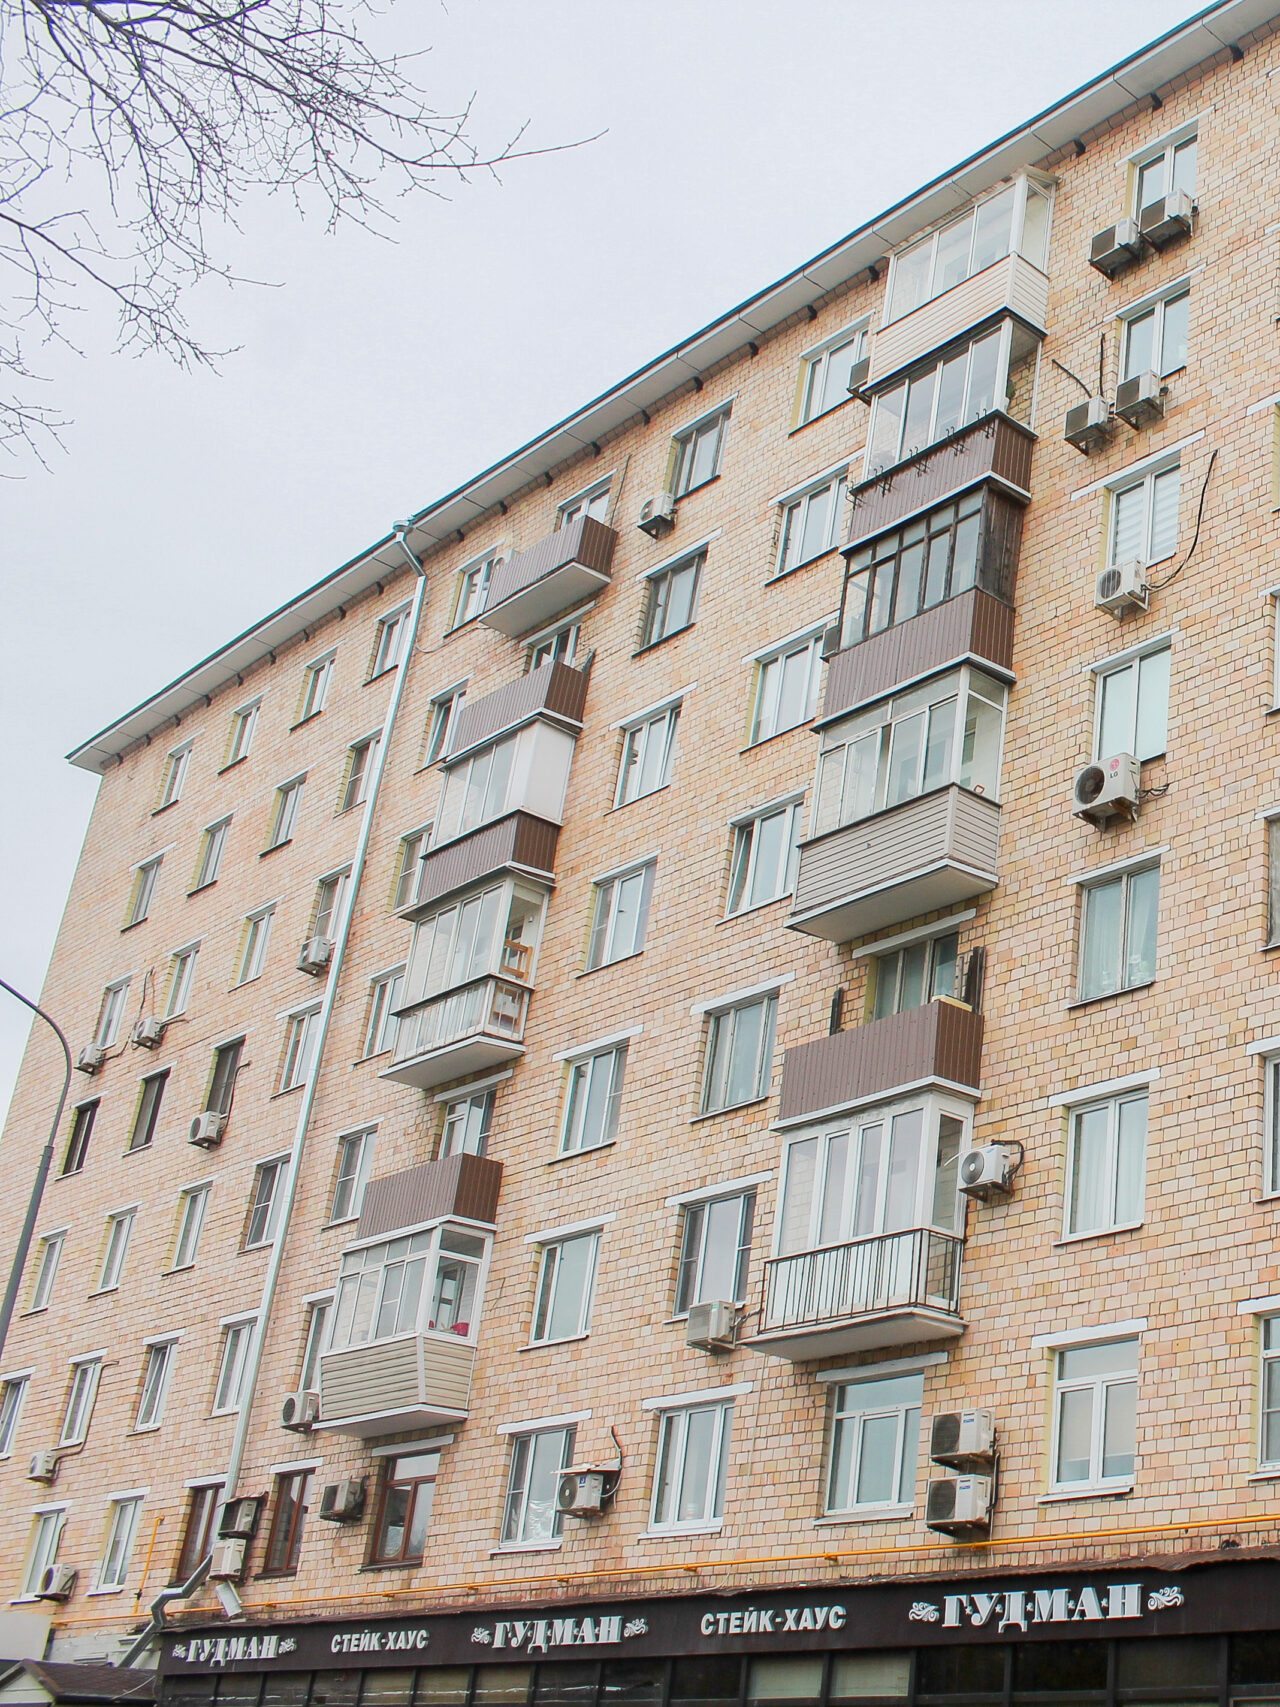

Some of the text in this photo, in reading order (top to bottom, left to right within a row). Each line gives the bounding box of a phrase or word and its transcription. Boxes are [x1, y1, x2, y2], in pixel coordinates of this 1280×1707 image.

[1109, 771, 1118, 779] LG
[700, 1605, 847, 1635] СТЕЙК-ХАУС
[942, 1583, 1144, 1633] ГУДМАН
[331, 1629, 429, 1653] СТЕЙК-ХАУС
[492, 1616, 624, 1653] ГУДМАН
[186, 1635, 279, 1667] ГУДМАН
